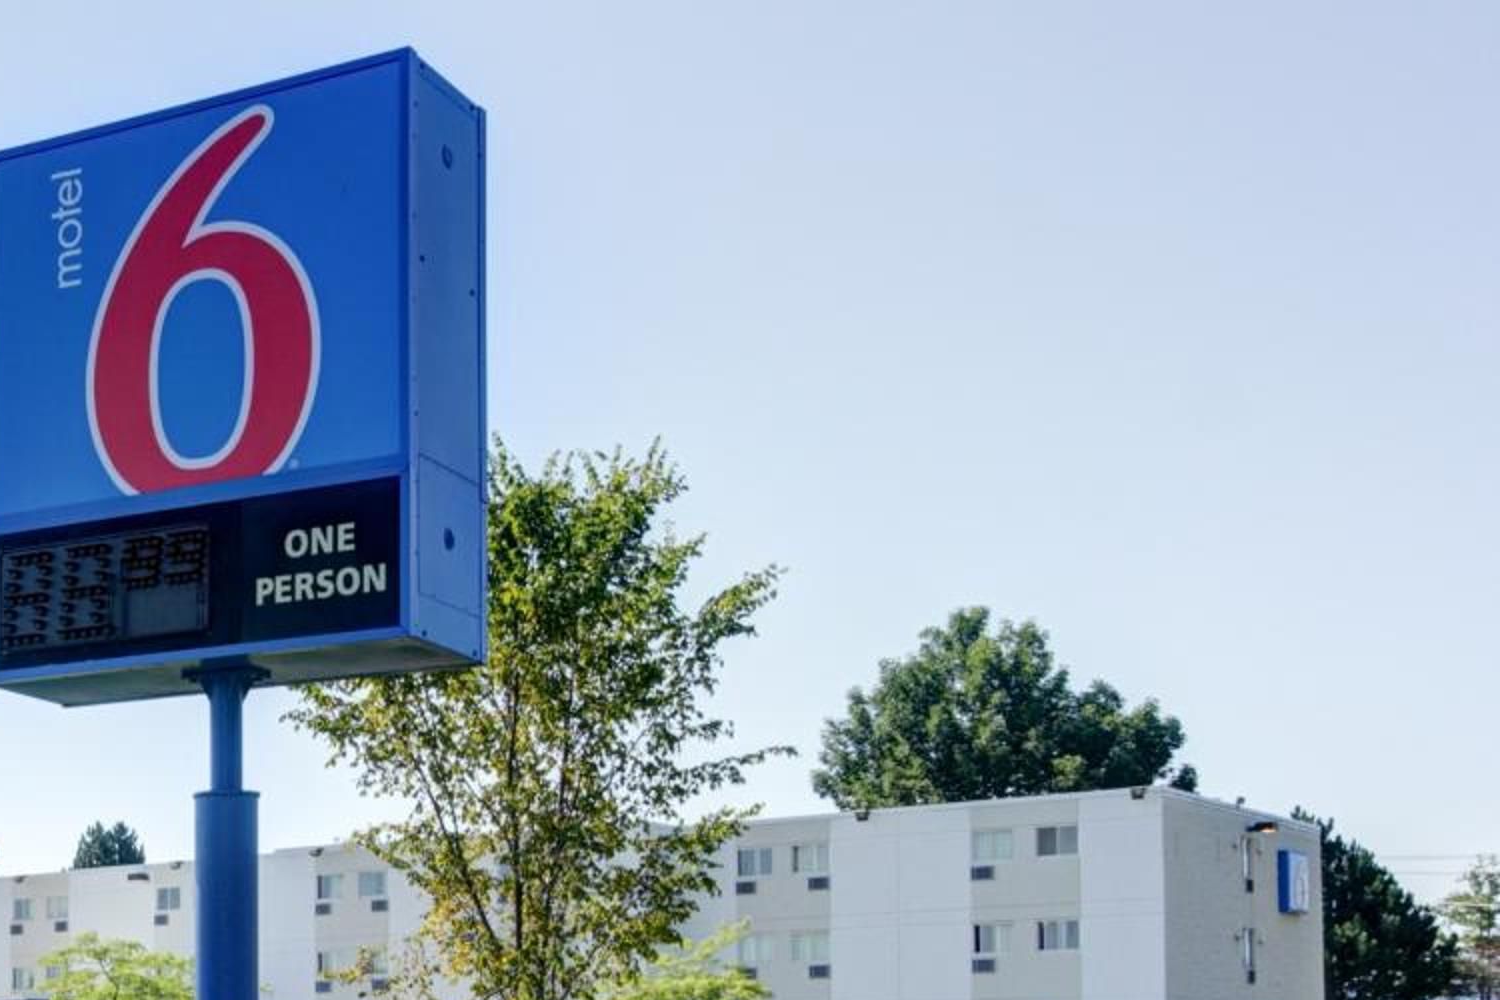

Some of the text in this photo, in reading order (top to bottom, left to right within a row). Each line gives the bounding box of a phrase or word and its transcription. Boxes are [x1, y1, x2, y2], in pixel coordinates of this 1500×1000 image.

[51, 167, 83, 289] motel
[85, 103, 322, 496] 6
[284, 521, 356, 559] ONE
[255, 562, 387, 607] PERSON
